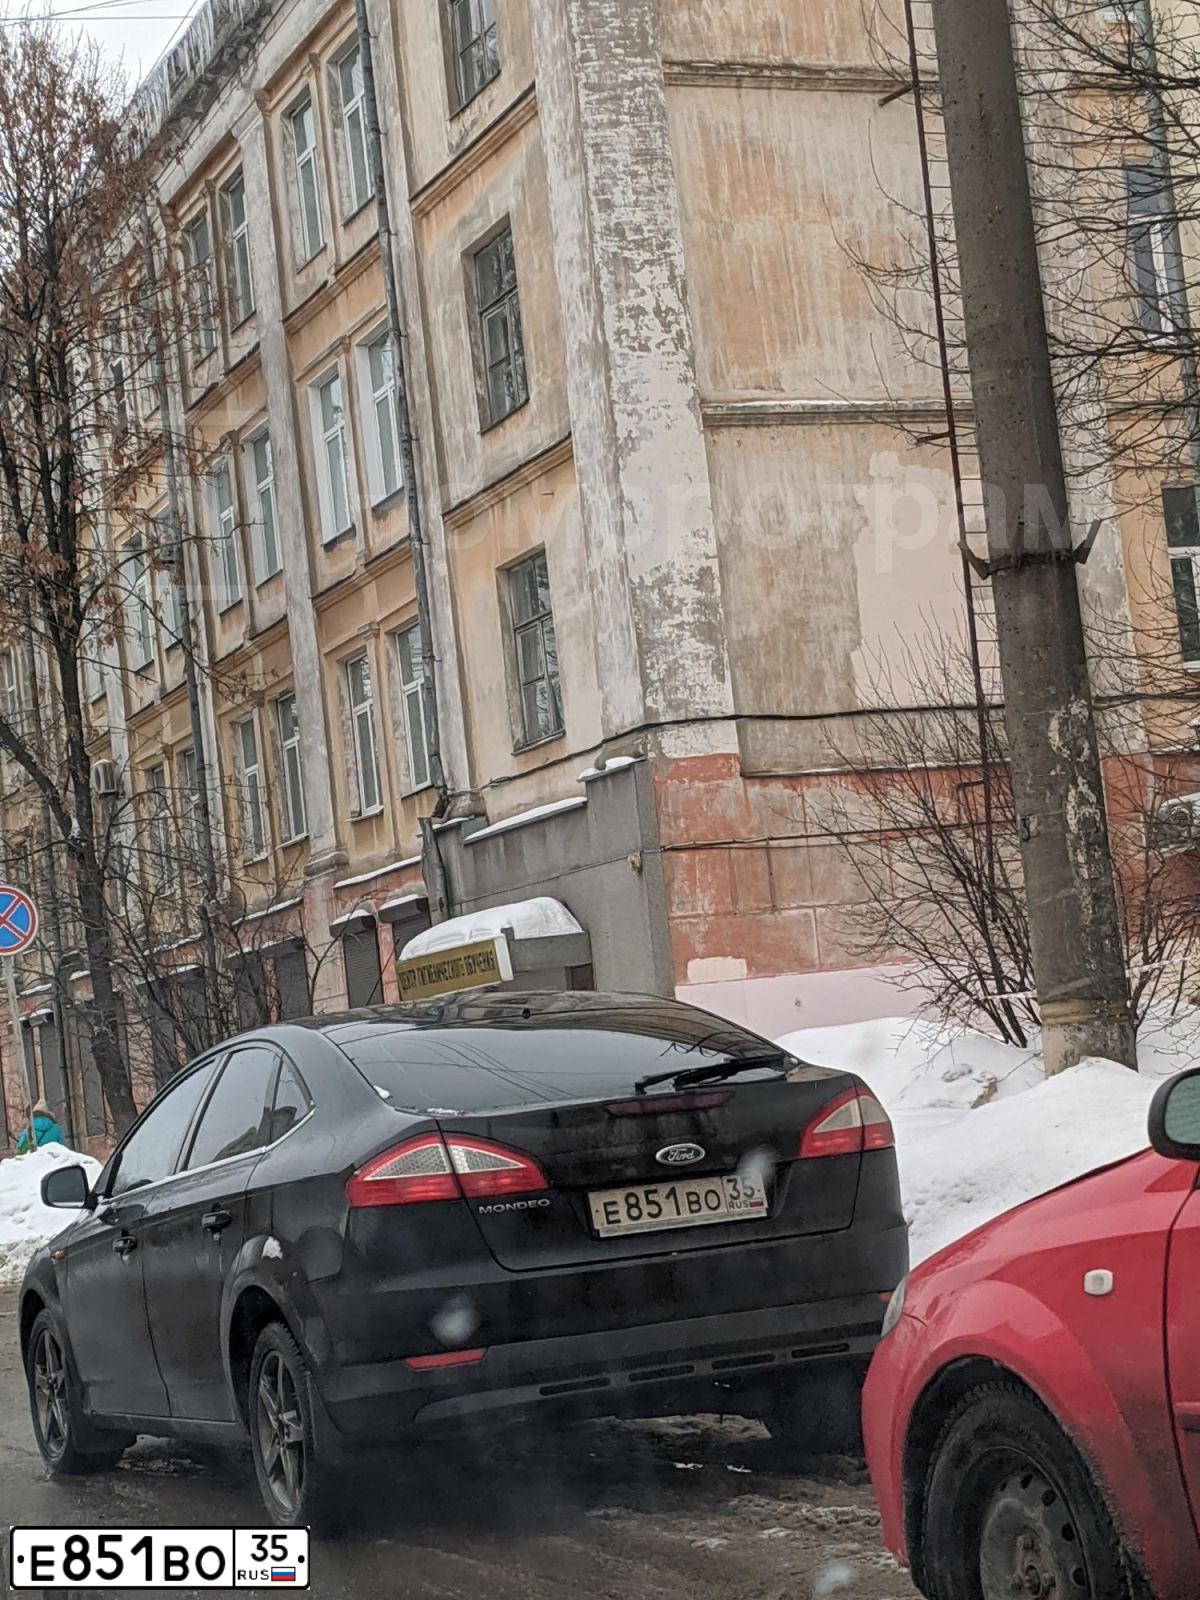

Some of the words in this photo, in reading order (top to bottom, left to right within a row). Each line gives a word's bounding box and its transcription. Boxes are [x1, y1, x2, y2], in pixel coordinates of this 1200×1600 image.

[668, 1147, 695, 1161] Ford
[726, 1177, 756, 1200] 35
[478, 1198, 551, 1214] MONDEO
[728, 1199, 749, 1210] RUS
